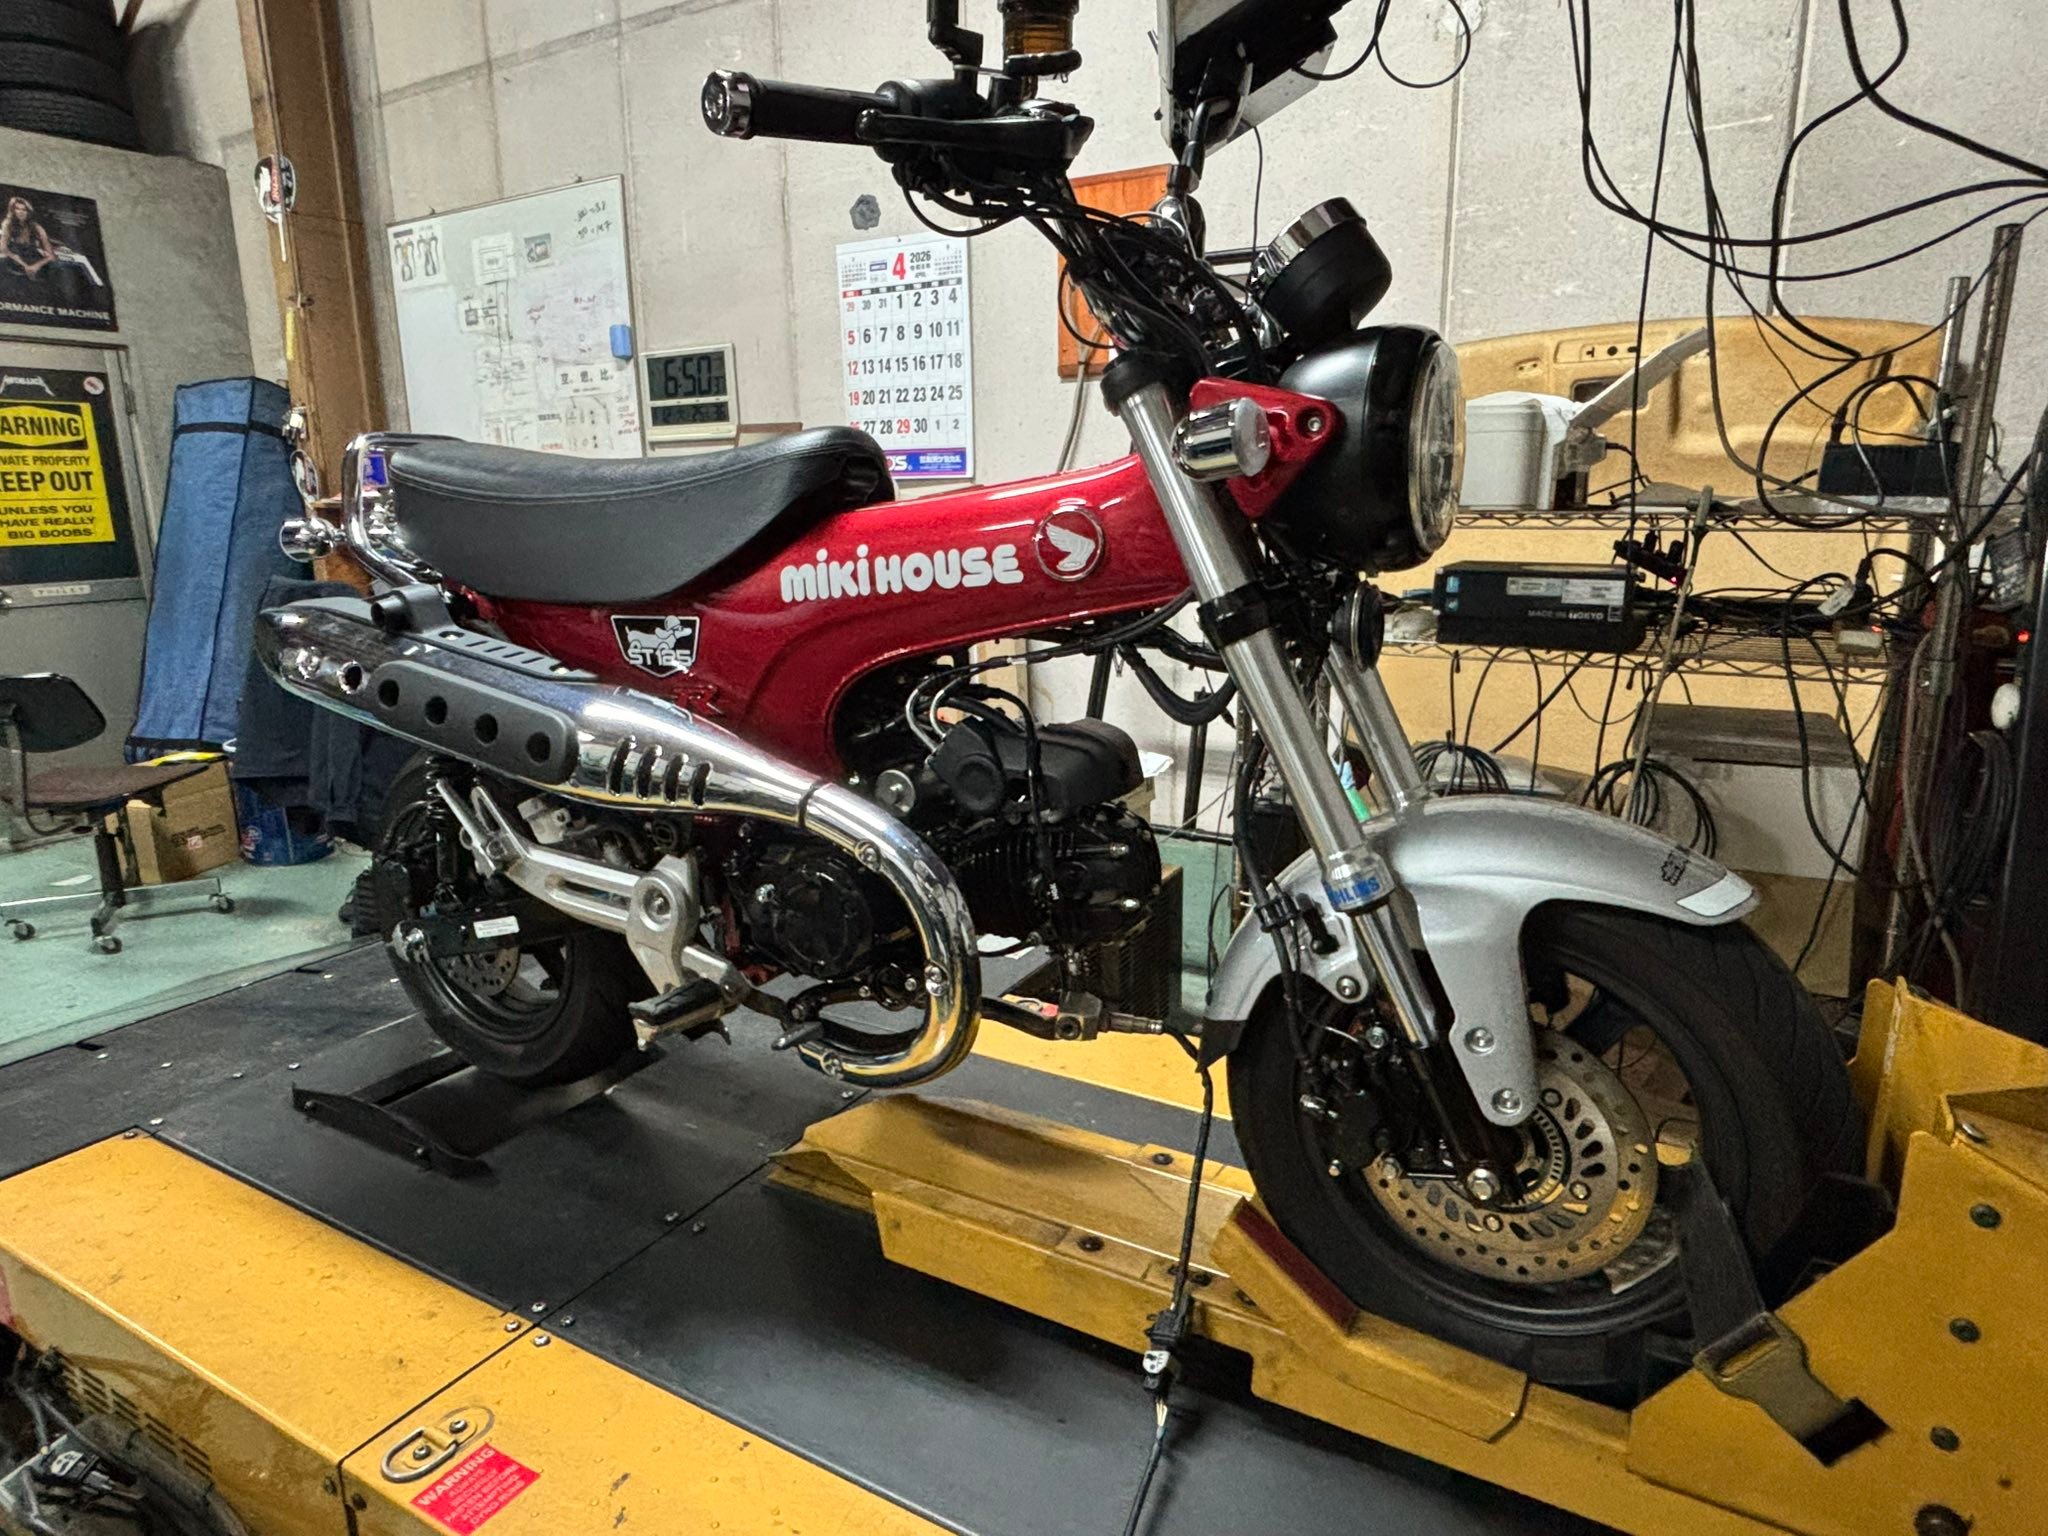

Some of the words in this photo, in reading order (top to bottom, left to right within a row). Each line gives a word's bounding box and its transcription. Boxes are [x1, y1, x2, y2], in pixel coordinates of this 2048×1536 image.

[892, 252, 906, 280] 4
[910, 250, 931, 263] 2026
[862, 300, 871, 311] 30
[878, 298, 887, 309] 31
[897, 294, 902, 309] 1
[913, 292, 922, 307] 2
[930, 290, 939, 306] 3
[948, 288, 958, 303] 4
[57, 307, 111, 321] MACHINE
[848, 330, 856, 345] 5
[863, 328, 871, 344] 6
[880, 327, 888, 342] 7
[896, 326, 905, 340] 8
[914, 324, 922, 339] 9
[930, 322, 942, 338] 10
[946, 321, 960, 336] 11
[848, 360, 858, 376] 12
[862, 359, 874, 374] 13
[878, 358, 891, 374] 14
[896, 357, 908, 372] 15
[912, 356, 926, 371] 16
[930, 354, 944, 370] 17
[948, 352, 962, 368] 18
[664, 356, 712, 397] 6:50
[850, 391, 860, 406] 19
[862, 390, 875, 405] 20
[879, 389, 890, 404] 21
[896, 388, 910, 403] 22
[913, 387, 926, 402] 23
[930, 386, 944, 401] 24
[948, 385, 962, 400] 25
[864, 420, 876, 435] 27
[880, 420, 893, 434] 28
[896, 418, 910, 434] 29
[914, 418, 928, 434] 30
[936, 419, 940, 430] 1
[953, 418, 960, 430] 2
[32, 455, 90, 466] PROPERTY
[0, 470, 46, 492] EEP
[50, 471, 93, 491] OUT
[0, 505, 58, 515] UNLESS
[62, 504, 92, 514] YOU
[0, 518, 40, 528] HAVE
[44, 516, 96, 526] REALLY
[8, 530, 35, 539] BIG
[873, 543, 1023, 595] HOUSE
[1528, 609, 1552, 618] MADE
[628, 640, 693, 666] ST125
[418, 1448, 495, 1506] WARNING
